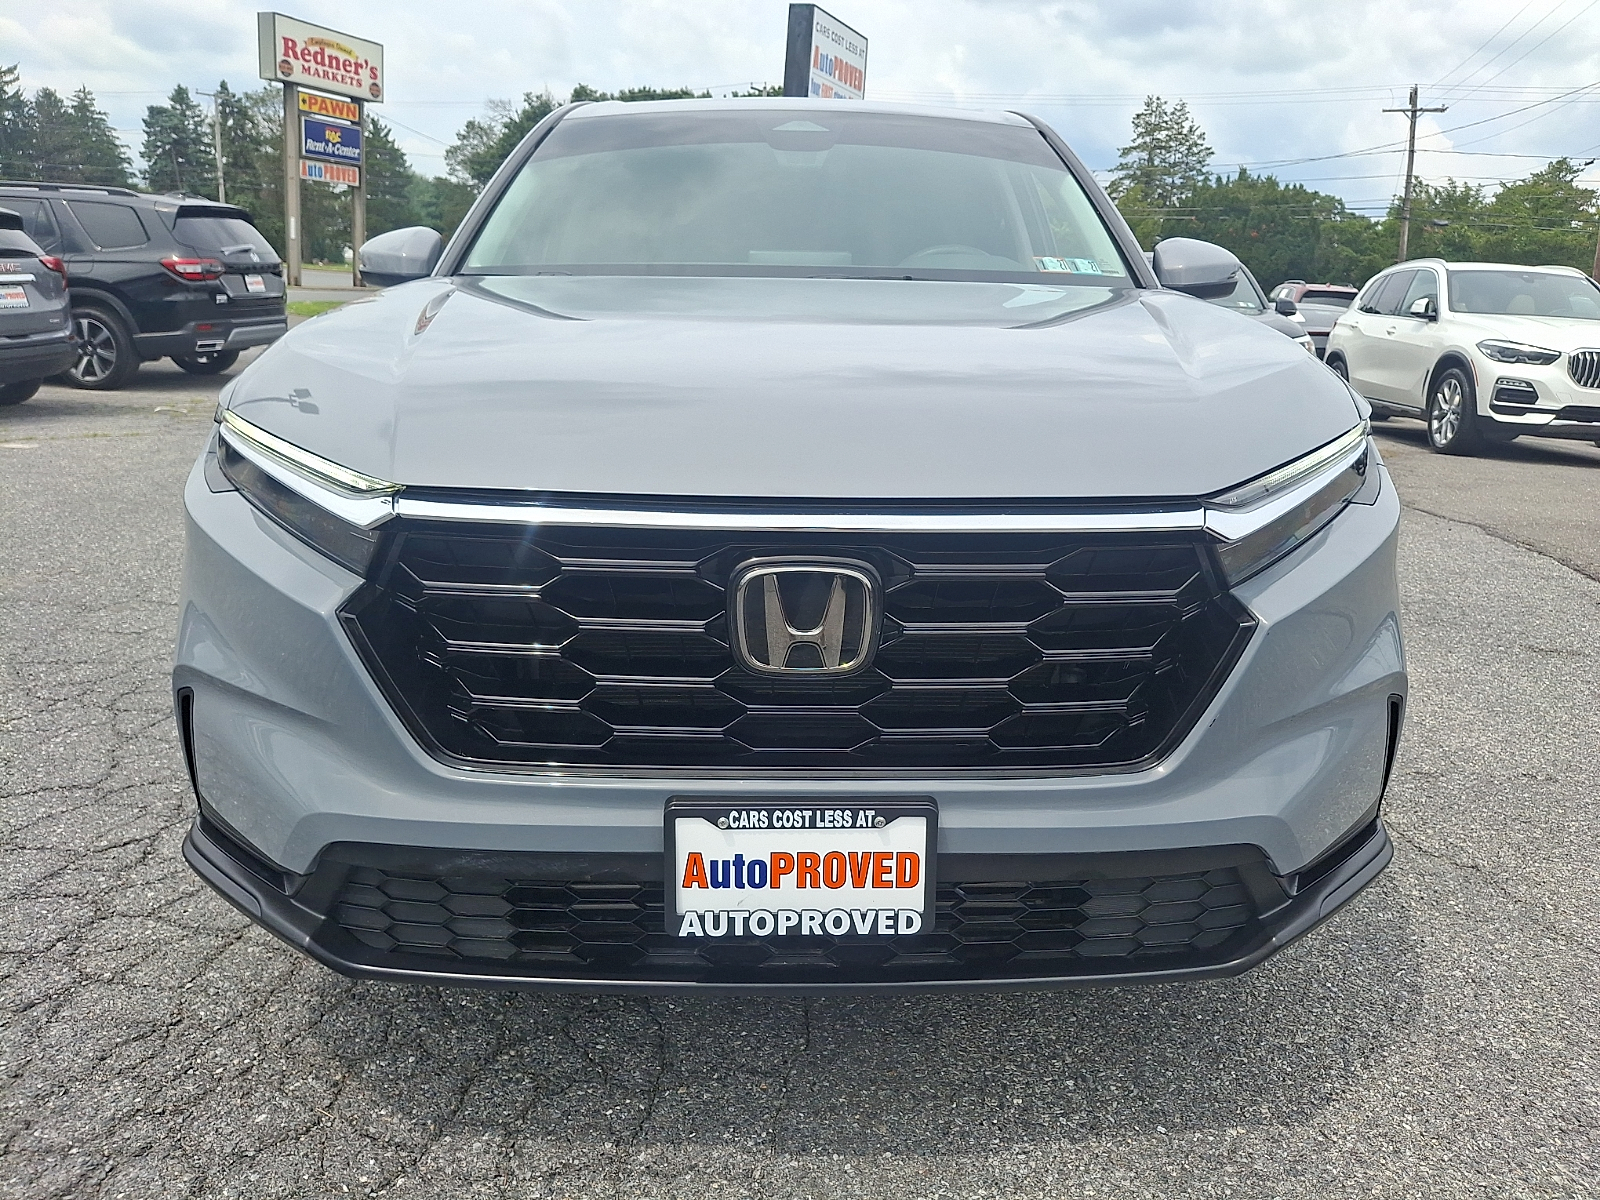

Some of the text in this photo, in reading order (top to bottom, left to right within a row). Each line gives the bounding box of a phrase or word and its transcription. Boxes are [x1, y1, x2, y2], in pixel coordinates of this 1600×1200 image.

[816, 21, 830, 39] CARS
[831, 31, 845, 47] COST
[845, 40, 858, 55] LESS
[282, 36, 378, 80] Redner's
[302, 64, 363, 88] MARKETS
[308, 94, 357, 119] PAWN
[729, 810, 875, 828] CARS COST LESS AT
[682, 851, 920, 889] AutoPROVED
[678, 908, 922, 937] AUTOPROVED
